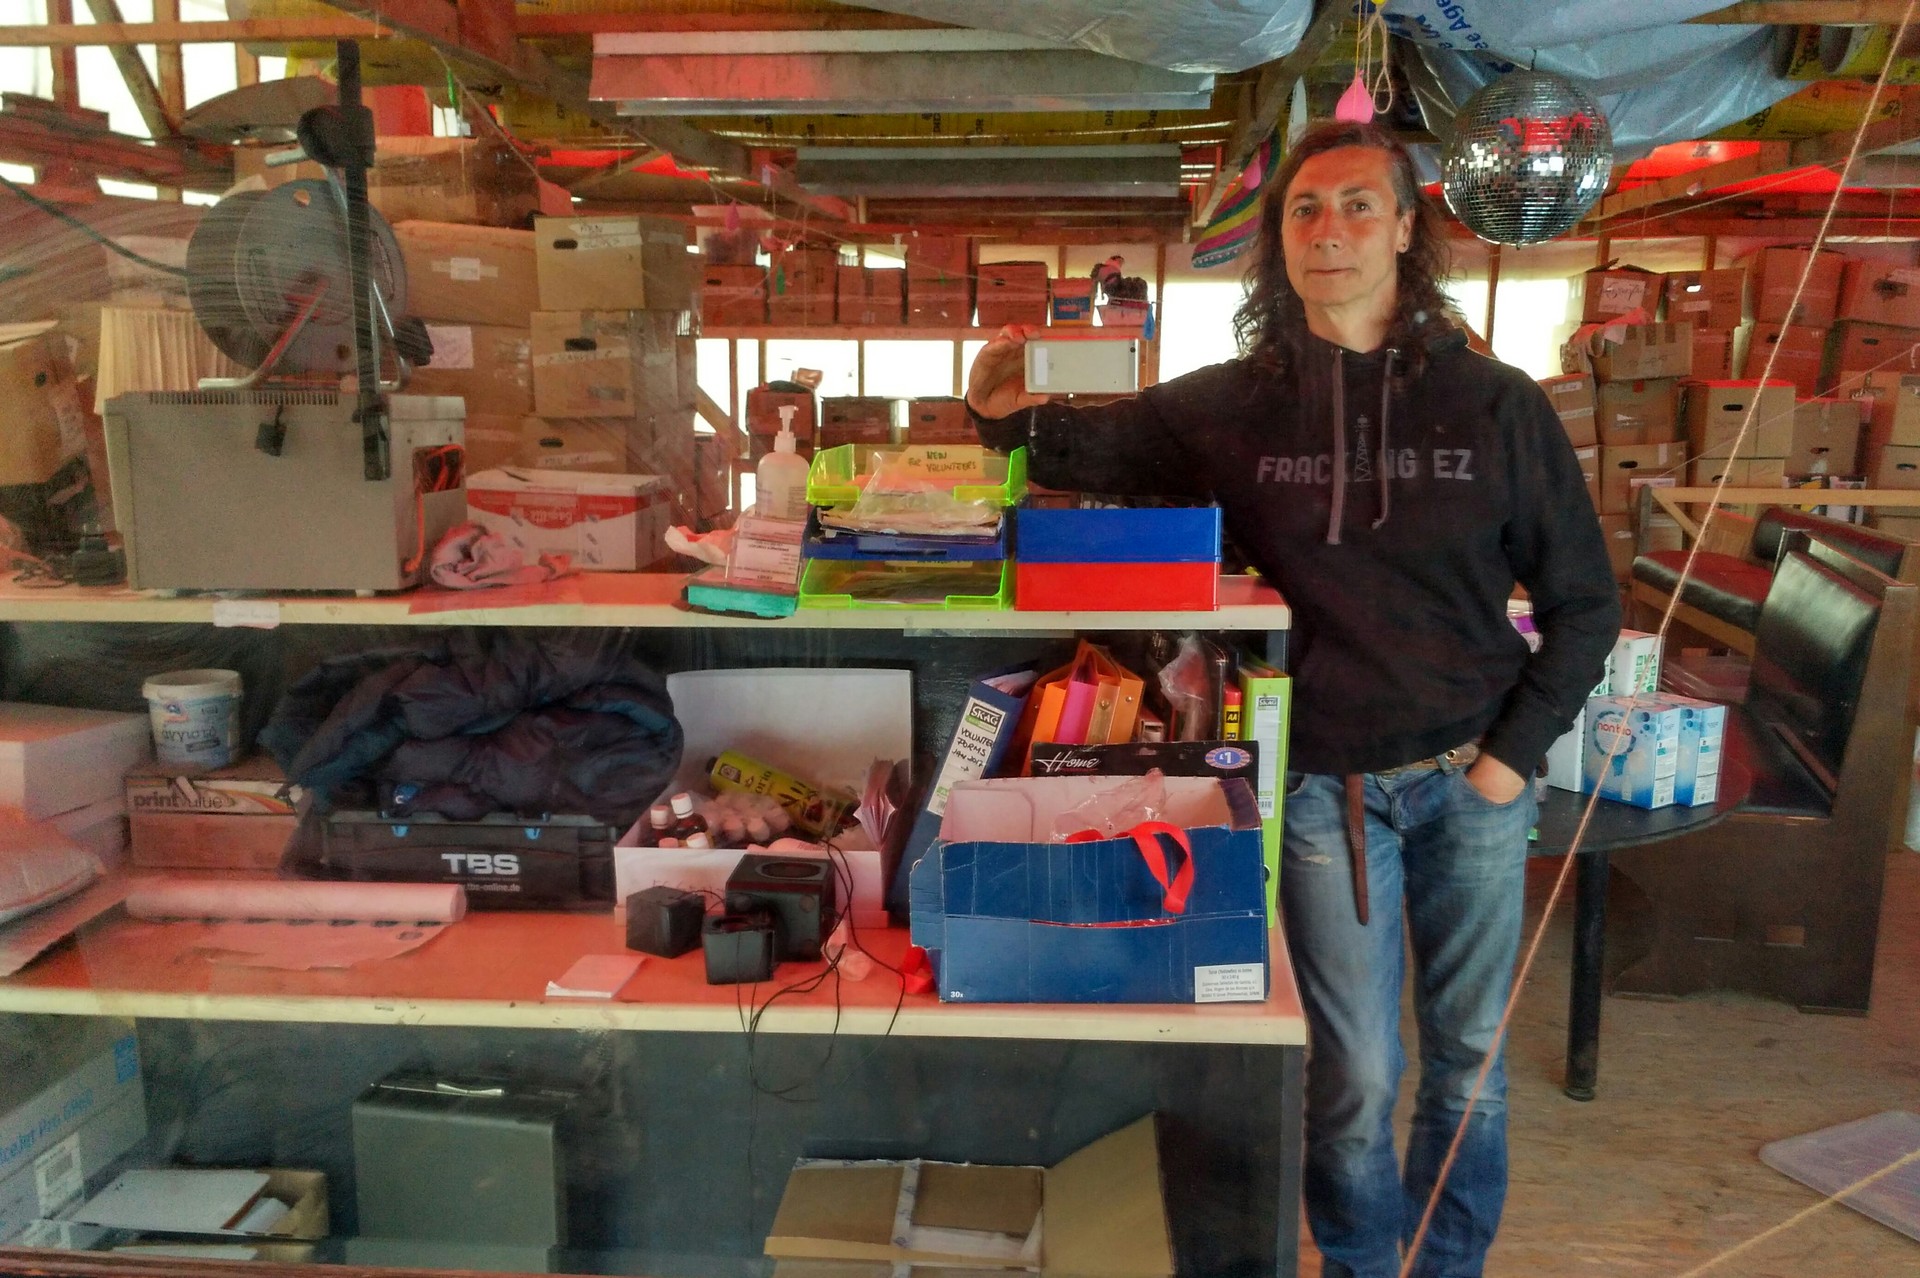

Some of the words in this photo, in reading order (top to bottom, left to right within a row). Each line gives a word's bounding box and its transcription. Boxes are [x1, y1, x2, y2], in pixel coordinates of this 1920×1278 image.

[1433, 448, 1475, 481] EZ
[971, 705, 1000, 726] SKAG
[1227, 713, 1238, 721] AA
[957, 737, 987, 757] FORMS
[1036, 750, 1100, 773] Home
[1219, 752, 1232, 764] £1
[441, 853, 519, 875] TBS
[950, 990, 964, 998] 30x
